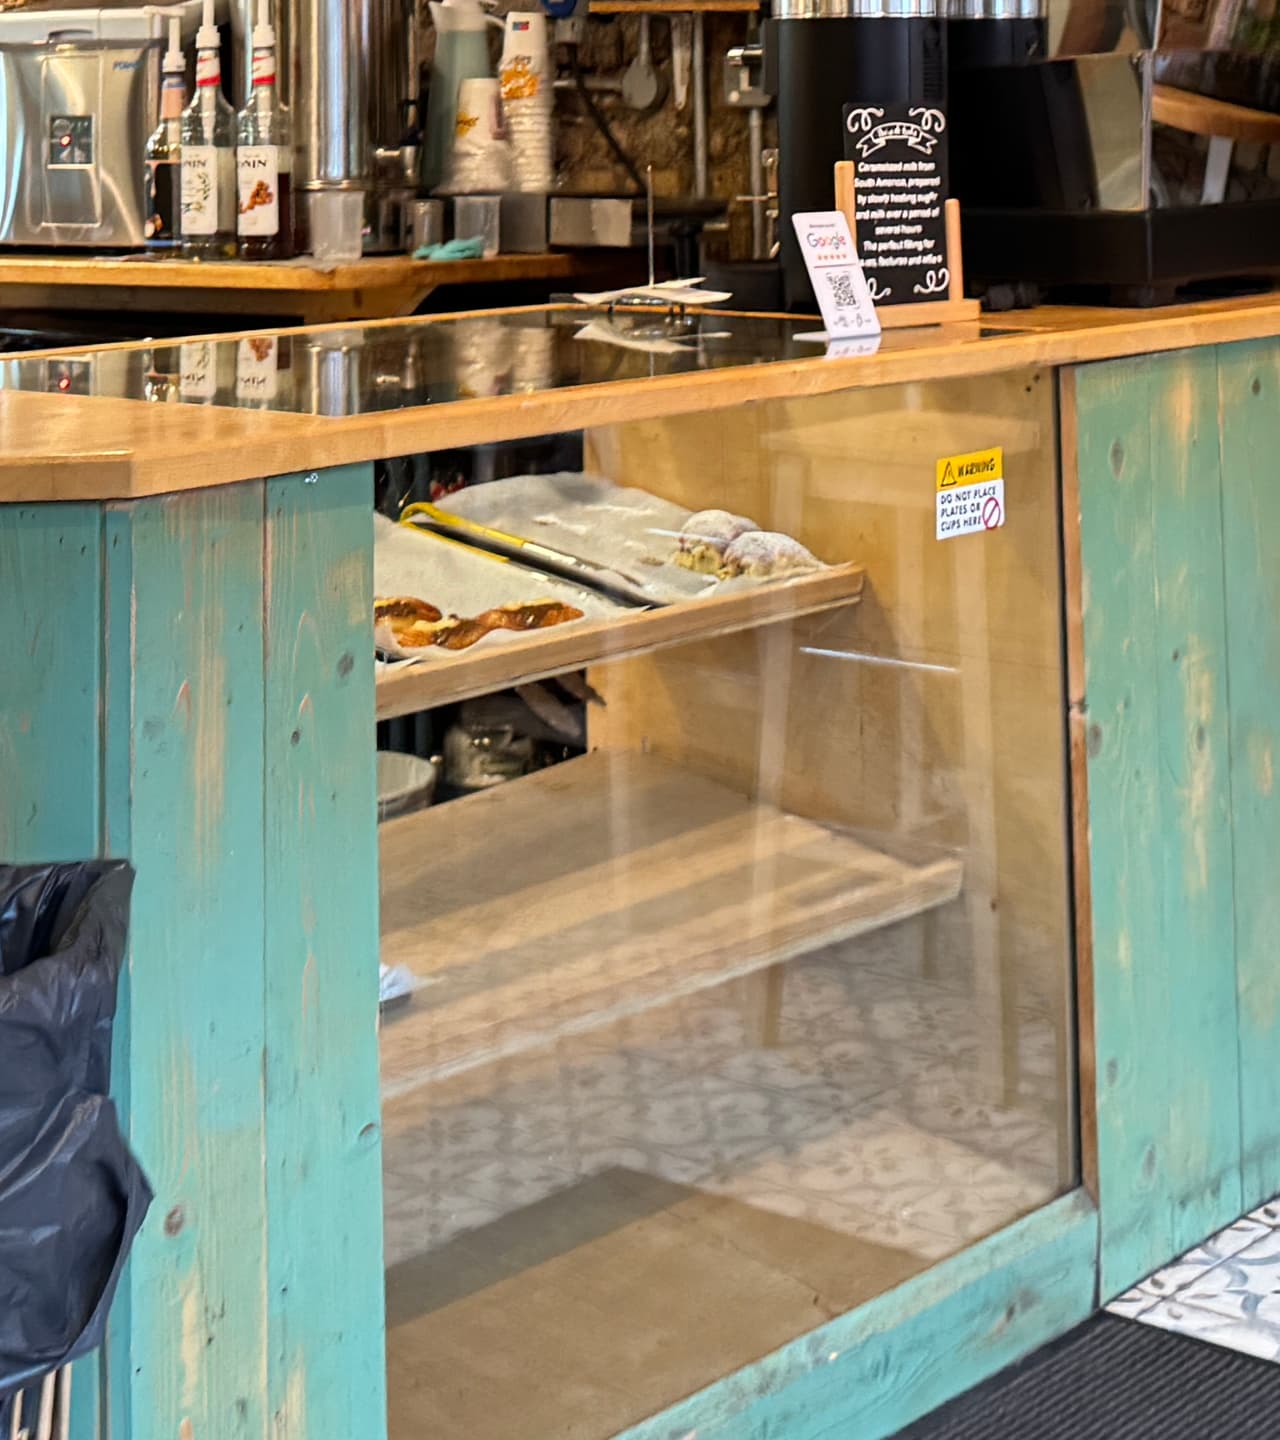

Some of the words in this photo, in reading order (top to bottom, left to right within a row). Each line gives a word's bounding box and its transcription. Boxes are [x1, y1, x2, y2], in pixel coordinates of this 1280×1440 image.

[806, 231, 847, 251] Google
[957, 457, 996, 478] WARNING
[940, 493, 954, 505] DO
[955, 489, 972, 503] NOT
[973, 485, 997, 499] PLACE
[940, 503, 968, 519] PLATES
[969, 501, 981, 513] OR
[940, 518, 962, 532] CUPS
[962, 515, 983, 528] HERE
